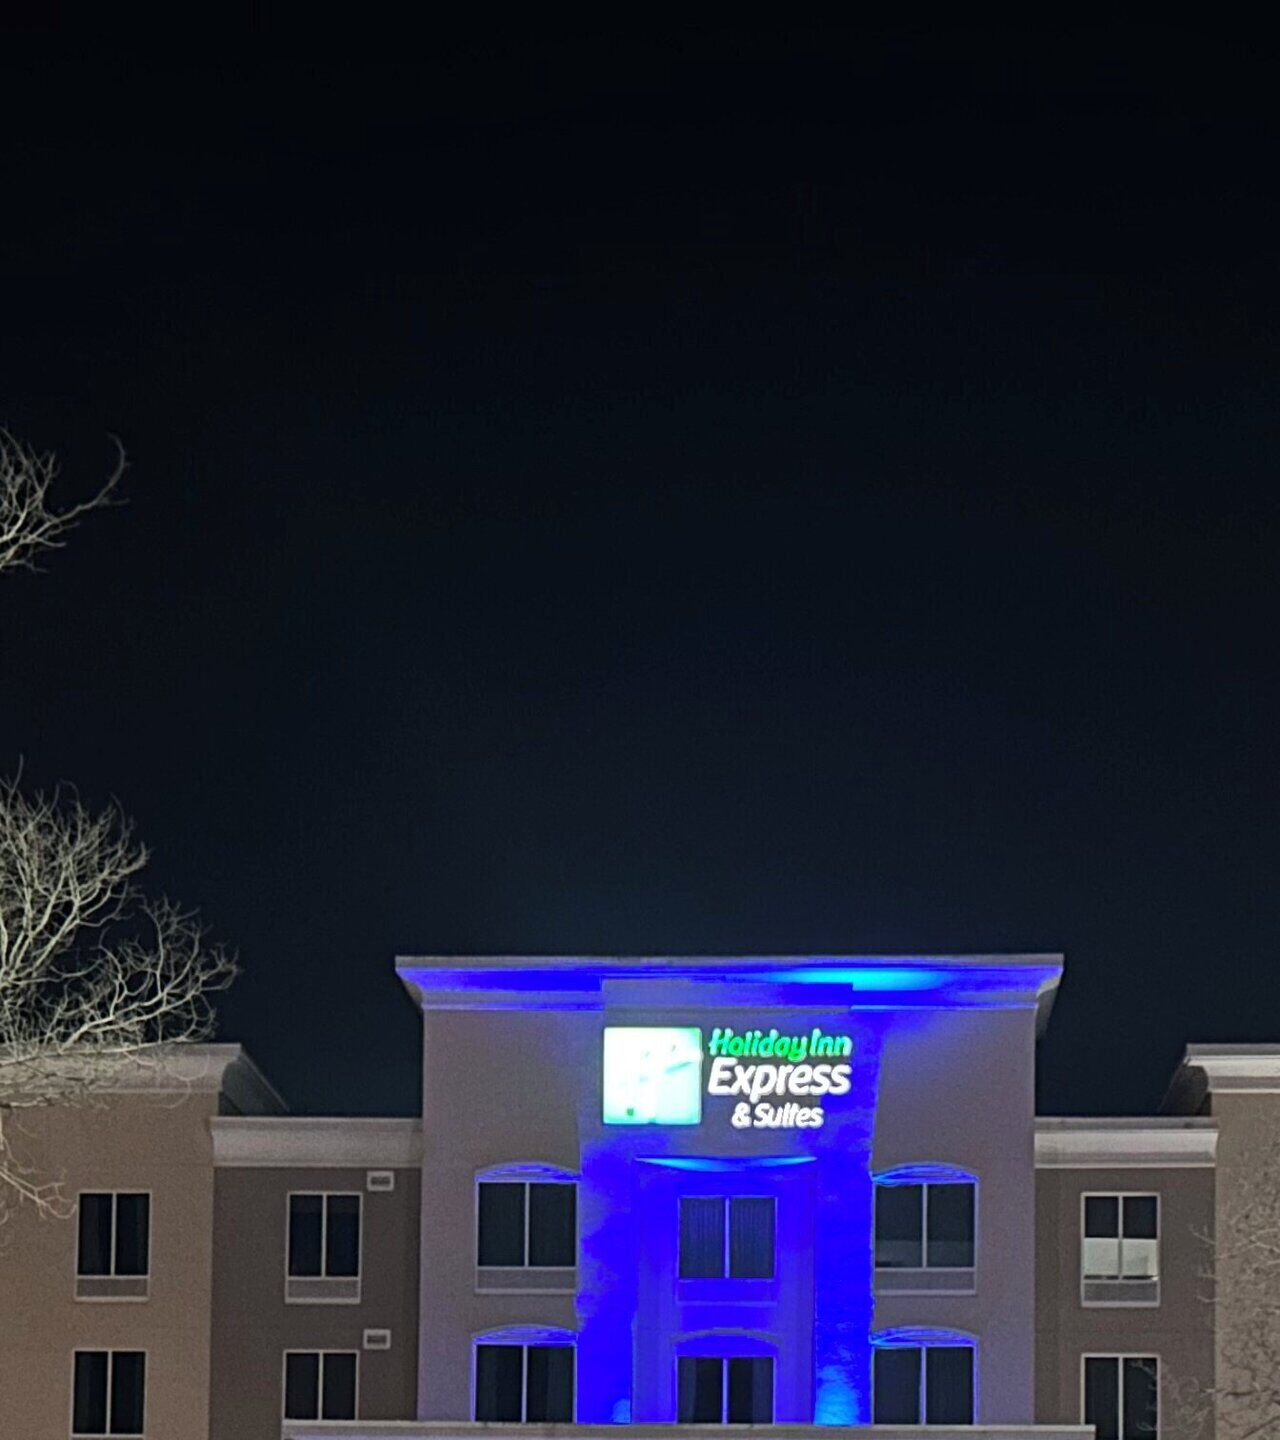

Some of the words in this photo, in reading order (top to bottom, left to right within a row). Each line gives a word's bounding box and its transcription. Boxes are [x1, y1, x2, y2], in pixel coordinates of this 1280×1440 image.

[708, 1028, 808, 1062] Holiday
[809, 1028, 852, 1056] Inn
[707, 1056, 852, 1104] Express
[731, 1102, 752, 1128] &
[753, 1101, 824, 1128] Suites
